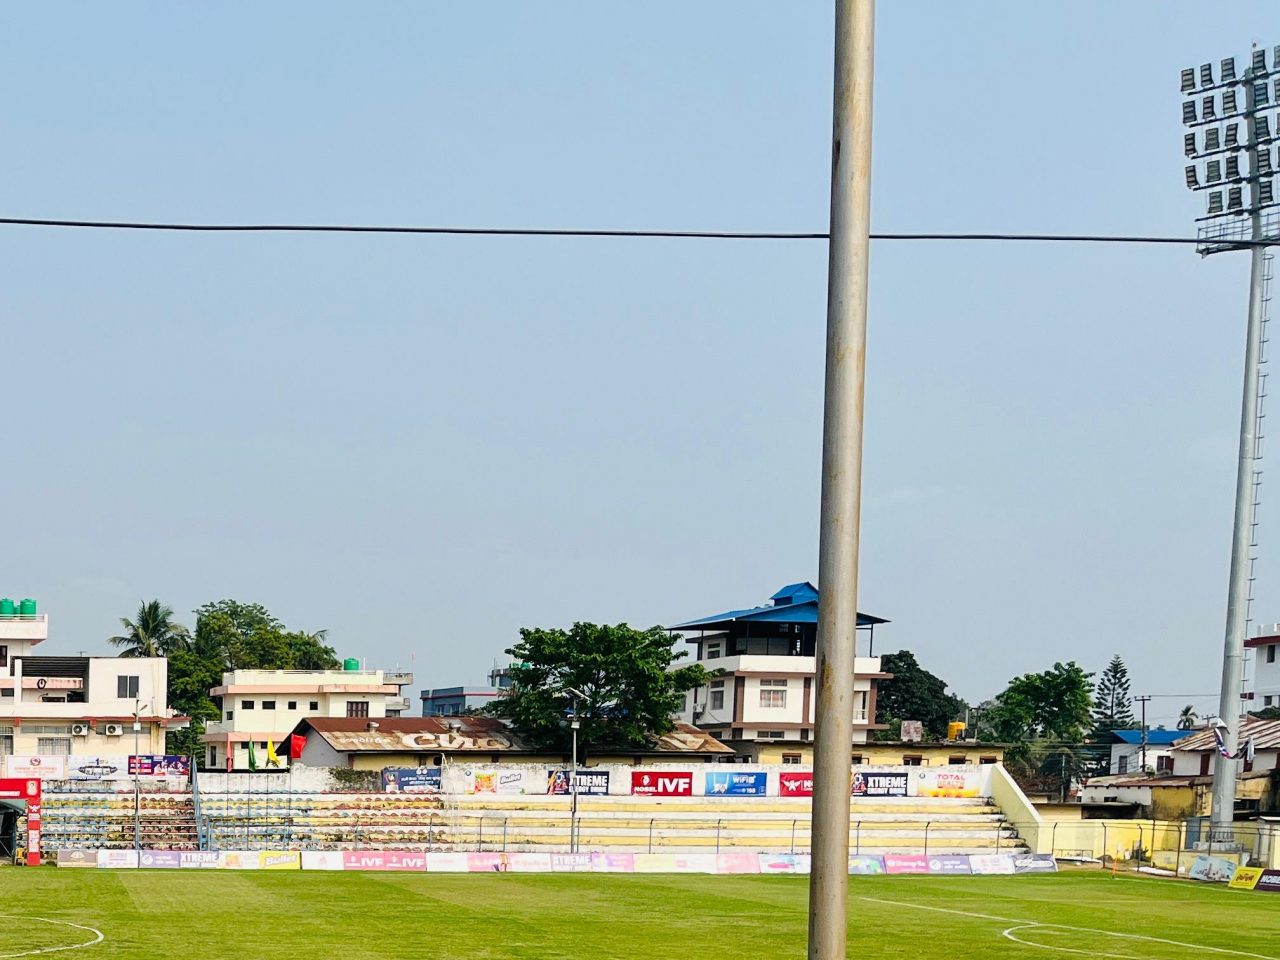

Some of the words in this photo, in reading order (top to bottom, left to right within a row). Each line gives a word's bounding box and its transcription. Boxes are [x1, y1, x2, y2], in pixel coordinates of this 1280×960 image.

[658, 778, 690, 793] IVF
[867, 776, 907, 788] XTREME
[181, 852, 218, 863] XTREME
[266, 855, 297, 865] Bullet
[361, 857, 384, 867] IVF
[553, 857, 592, 866] XTREME
[402, 858, 425, 868] IVF
